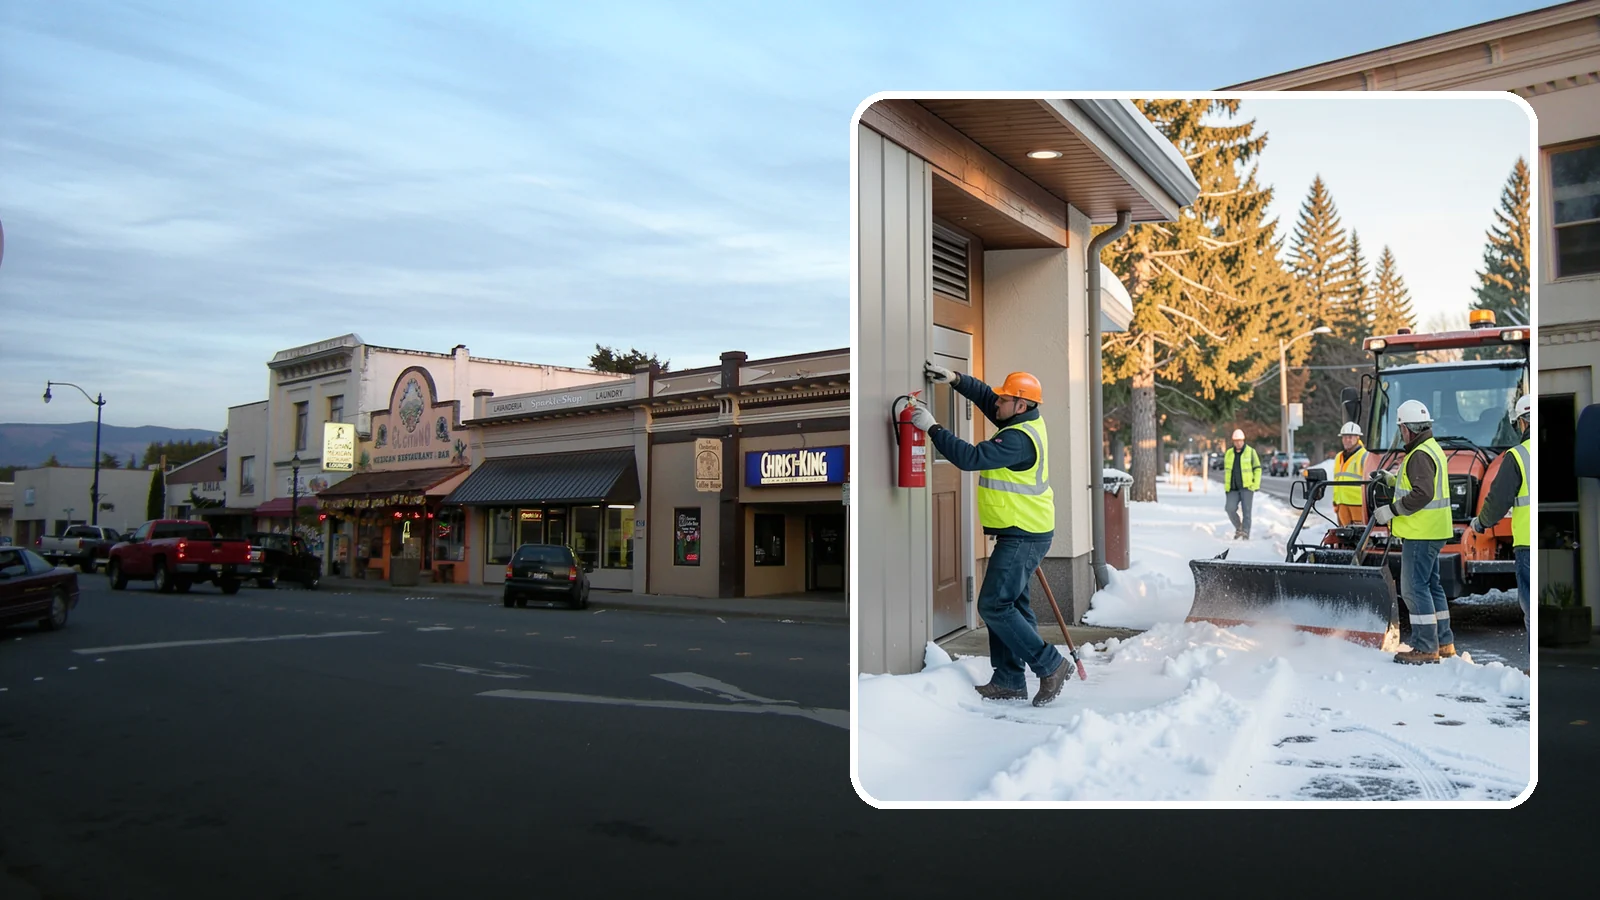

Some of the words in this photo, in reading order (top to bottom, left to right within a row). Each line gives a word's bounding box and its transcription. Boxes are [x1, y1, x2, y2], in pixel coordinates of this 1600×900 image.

[561, 394, 582, 404] Shop
[595, 388, 624, 400] LAUNDRY
[494, 401, 523, 413] LAVANDERIA
[397, 451, 434, 463] RESTAURANT
[437, 450, 450, 459] BAR
[760, 451, 798, 478] CHRIST
[798, 450, 828, 476] KING
[696, 481, 709, 489] Coffee
